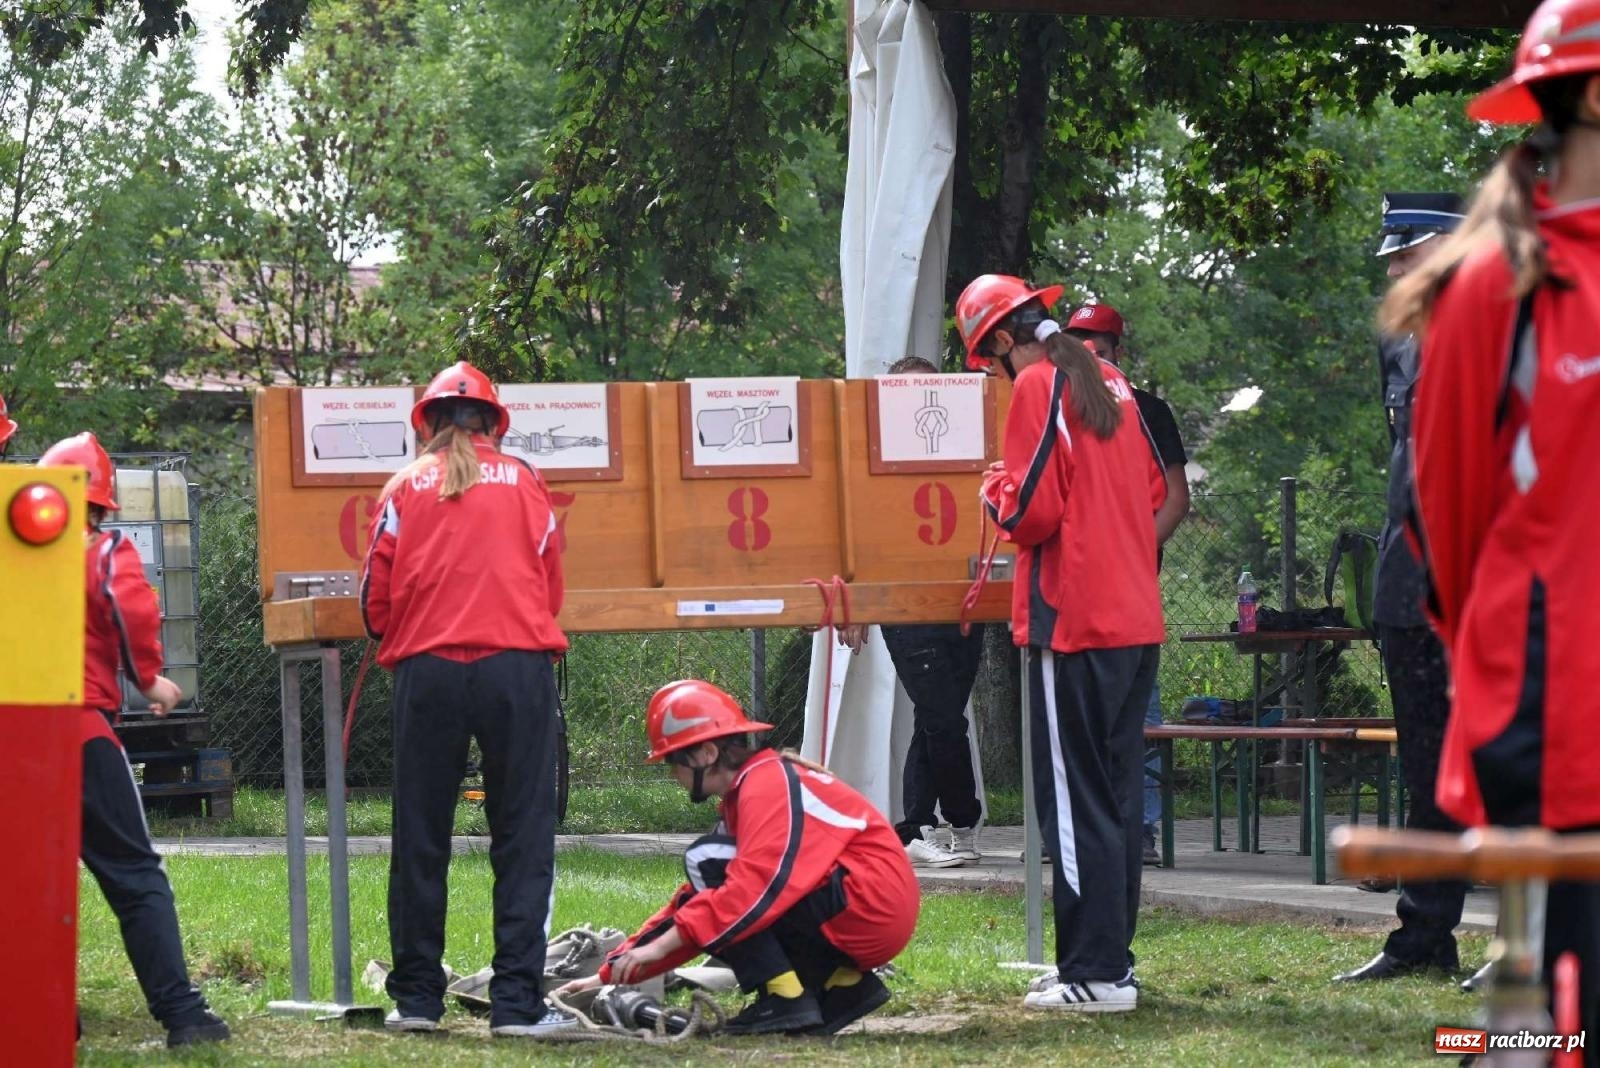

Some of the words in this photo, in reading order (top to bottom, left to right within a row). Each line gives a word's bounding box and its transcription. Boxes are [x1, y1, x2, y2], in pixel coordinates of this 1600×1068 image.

[353, 401, 396, 410] CIESIELSKI
[737, 388, 780, 398] MASZTOWY
[727, 487, 771, 551] 8
[913, 481, 957, 546] 9
